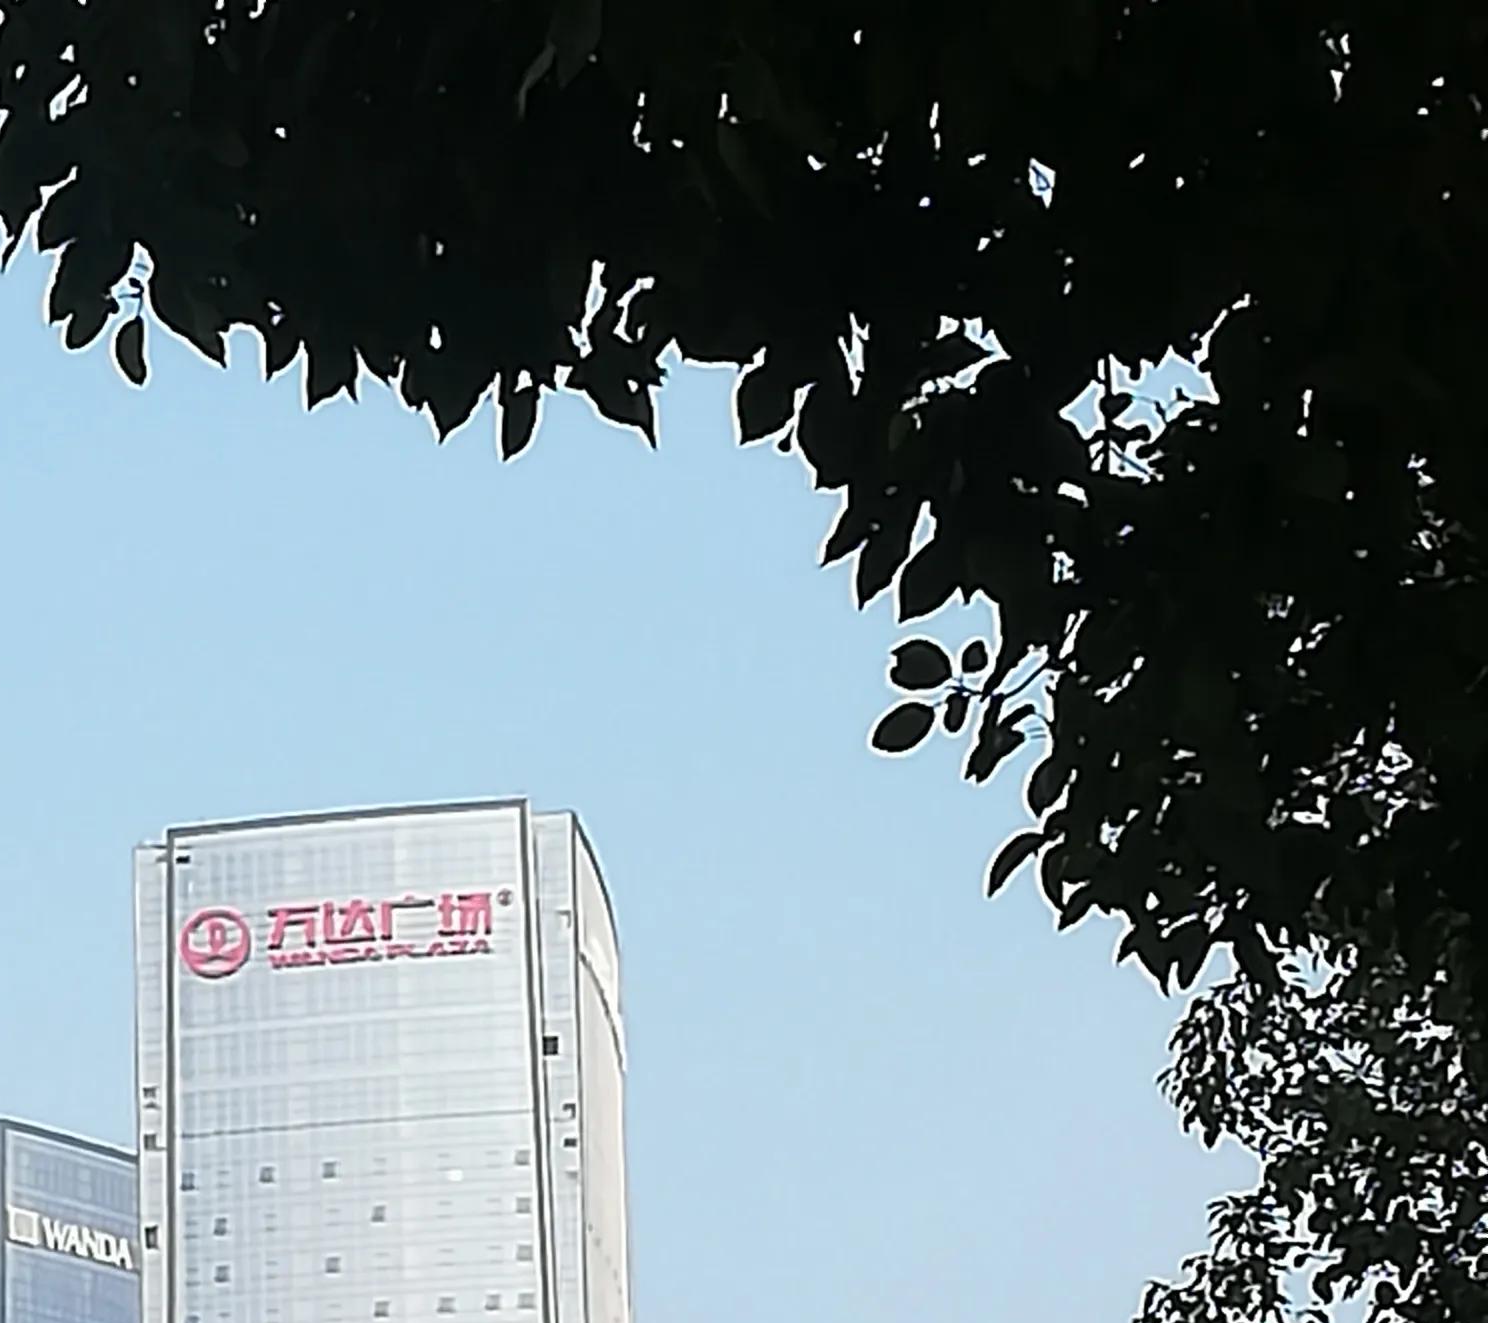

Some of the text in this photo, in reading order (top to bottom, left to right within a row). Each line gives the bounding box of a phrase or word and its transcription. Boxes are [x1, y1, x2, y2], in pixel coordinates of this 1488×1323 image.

[267, 893, 493, 950] 万达广场
[41, 1216, 133, 1270] WANDA
